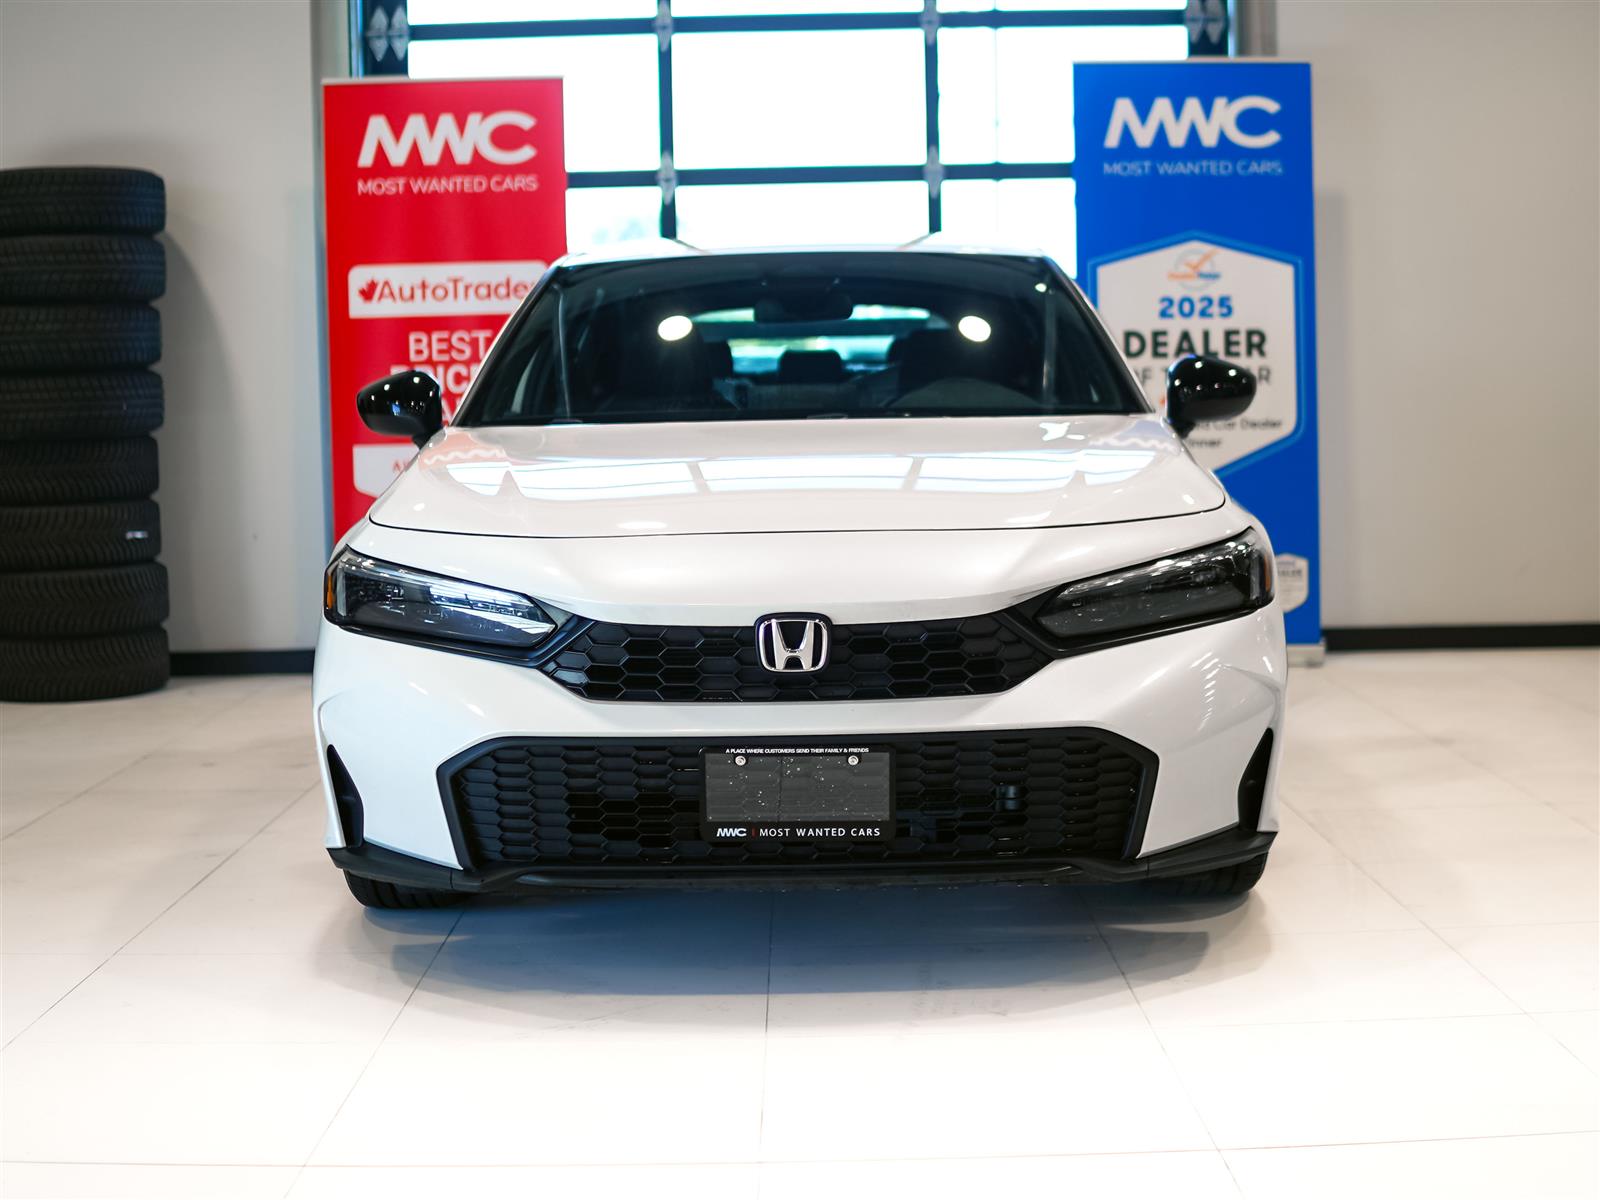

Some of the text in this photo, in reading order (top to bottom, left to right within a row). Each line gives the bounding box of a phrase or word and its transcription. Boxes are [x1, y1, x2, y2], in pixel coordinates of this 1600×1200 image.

[1103, 95, 1282, 149] MWC
[357, 110, 538, 168] MWC
[1103, 159, 1283, 176] MOST WANTED CARS
[357, 174, 539, 196] MOST WANTED CARS
[377, 276, 531, 303] AutoTrade
[1158, 295, 1234, 320] 2025
[408, 329, 493, 363] BEST
[1122, 329, 1267, 360] DEALER
[716, 827, 881, 837] MWC MOST WANTED CARS
